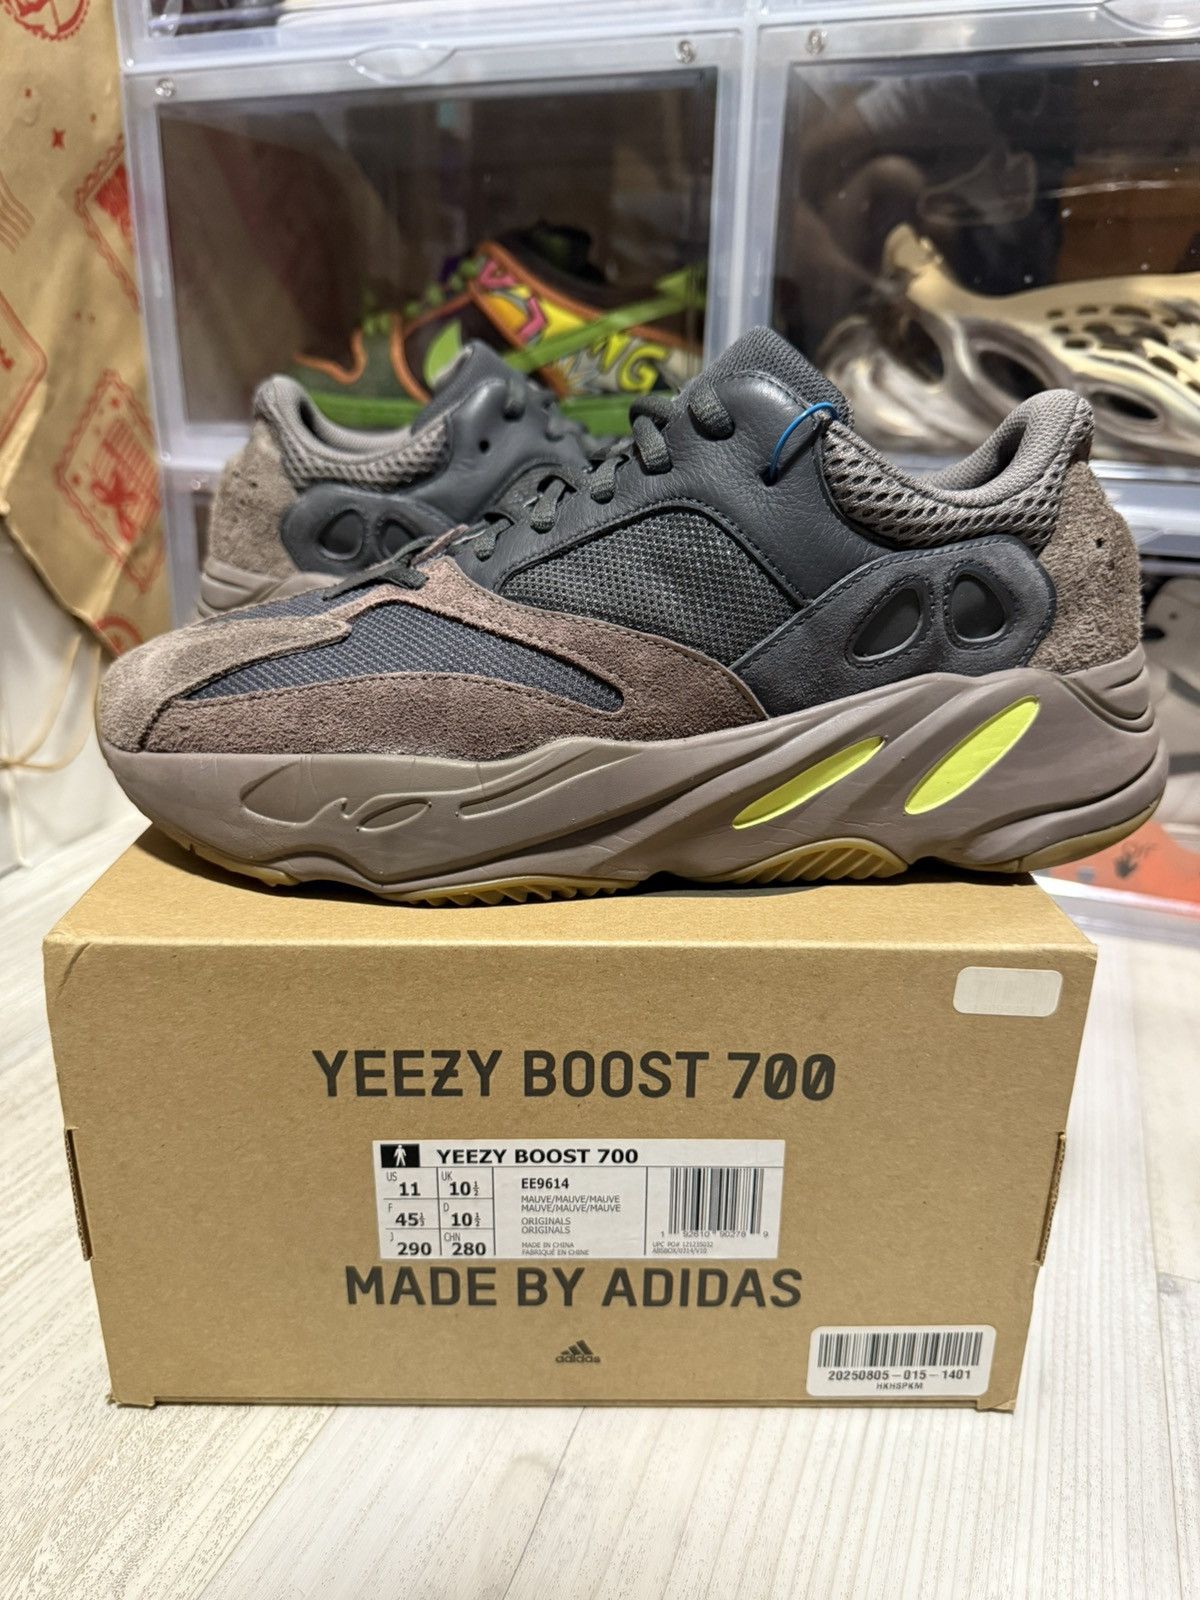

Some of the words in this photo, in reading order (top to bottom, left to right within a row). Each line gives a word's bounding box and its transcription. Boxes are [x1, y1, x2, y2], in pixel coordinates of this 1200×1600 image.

[312, 1050, 502, 1098] YEEZY
[523, 1050, 709, 1098] BOOST
[727, 1052, 837, 1100] 700
[437, 1148, 508, 1164] YEEZY
[514, 1148, 591, 1164] BOOST
[597, 1148, 639, 1164] 700
[386, 1171, 398, 1182] US
[441, 1170, 453, 1181] UK
[399, 1181, 421, 1197] 11
[521, 1177, 570, 1190] EE9614
[521, 1195, 621, 1204] MAUVE/MAUVE/MAUVE
[388, 1203, 393, 1213] F
[443, 1202, 450, 1212] D
[521, 1204, 622, 1213] MAUVE/MAUVE/MAUVE
[521, 1217, 572, 1226] ORIGINALS
[521, 1226, 572, 1235] ORIGINALS
[443, 1231, 461, 1242] CHN
[397, 1242, 433, 1257] 290
[452, 1242, 487, 1257] 280
[521, 1248, 555, 1257] FABRIQUE
[557, 1248, 567, 1256] EN
[344, 1265, 497, 1306] MADE
[516, 1266, 586, 1306] BY
[601, 1267, 804, 1308] ADIDAS
